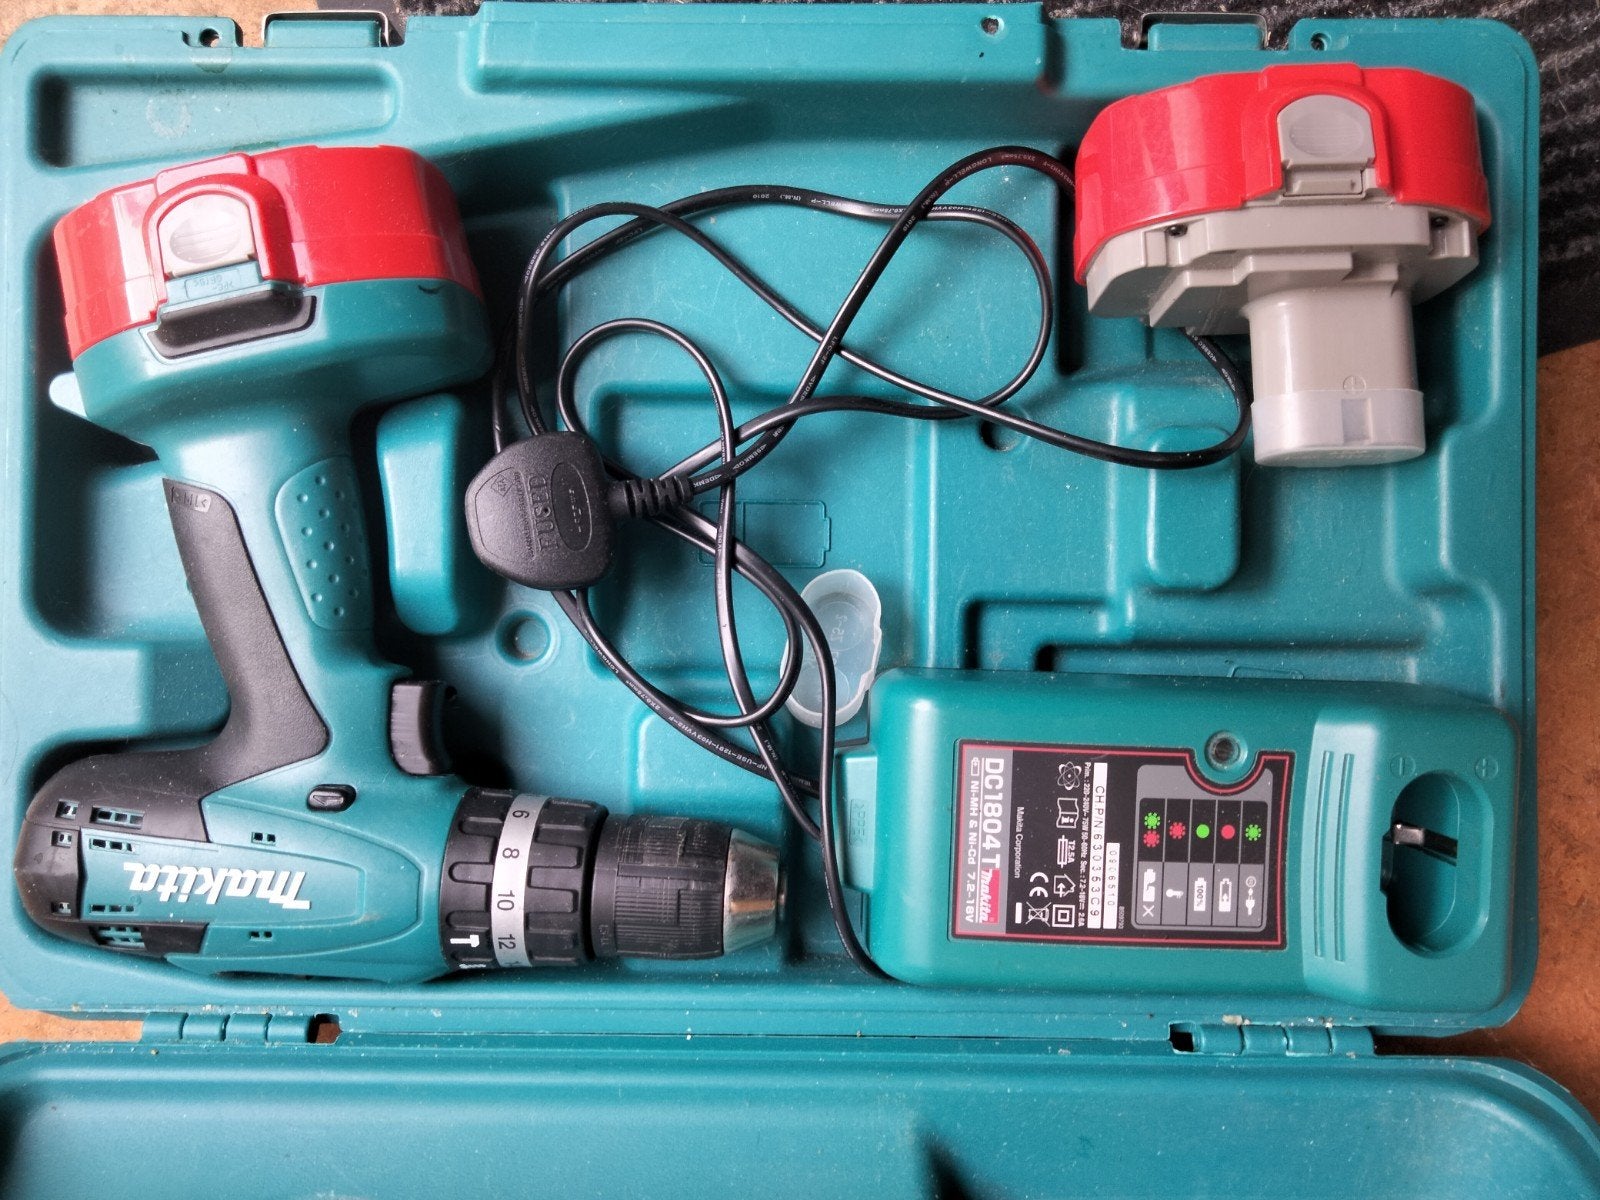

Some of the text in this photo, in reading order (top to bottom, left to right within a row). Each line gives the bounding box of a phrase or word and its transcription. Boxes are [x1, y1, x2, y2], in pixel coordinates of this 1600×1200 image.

[969, 781, 979, 816] Ni-MH
[513, 810, 529, 818] 6
[969, 820, 977, 828] &
[502, 848, 519, 859] 8
[968, 832, 977, 865] Ni-Cd
[1014, 807, 1025, 878] Makita Corporation
[1029, 872, 1049, 897] CE
[1196, 884, 1204, 907] 100%
[497, 890, 515, 911] 10
[498, 934, 516, 949] 12
